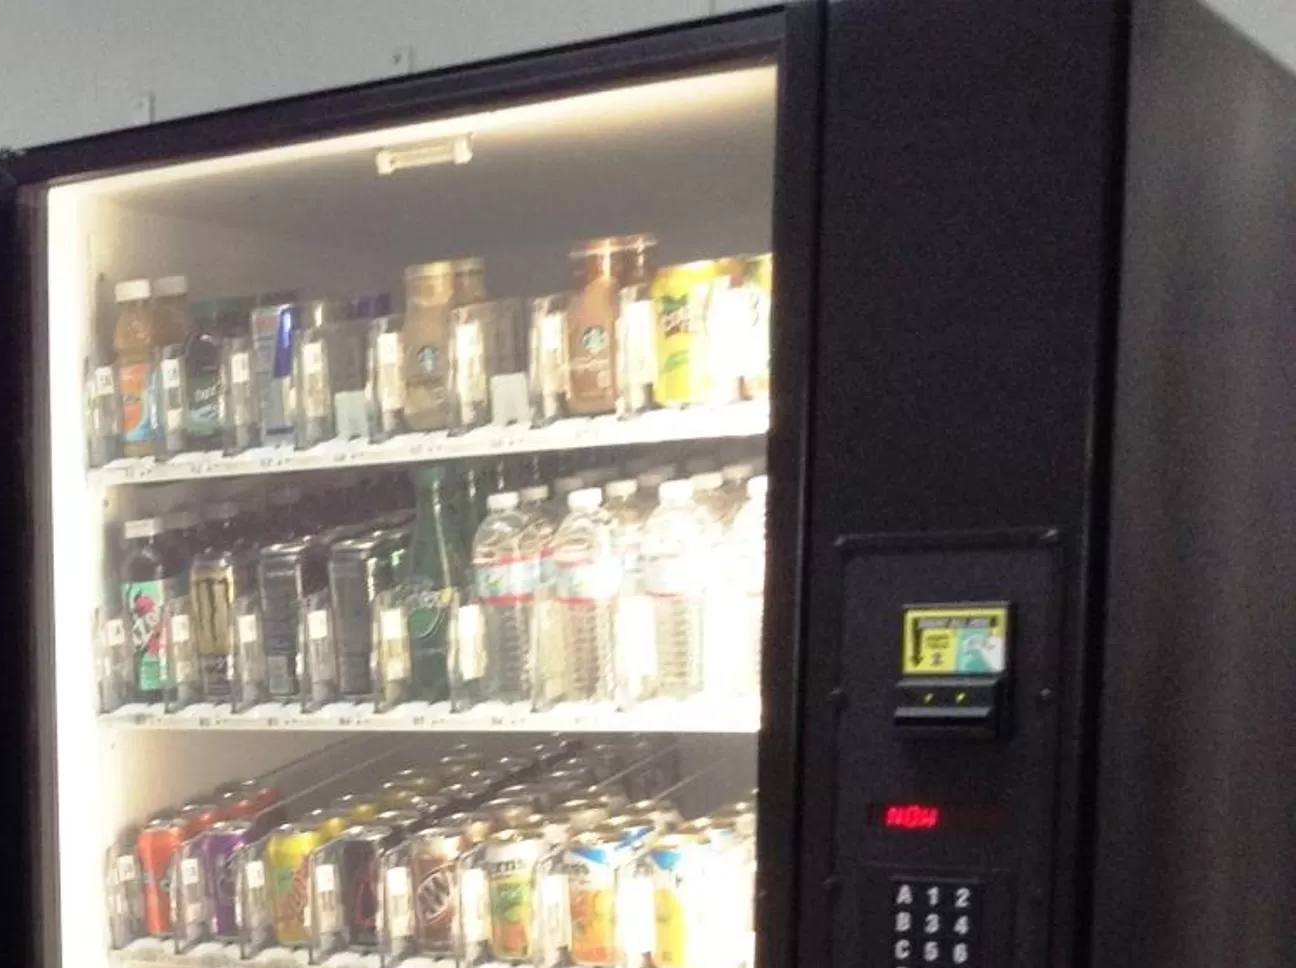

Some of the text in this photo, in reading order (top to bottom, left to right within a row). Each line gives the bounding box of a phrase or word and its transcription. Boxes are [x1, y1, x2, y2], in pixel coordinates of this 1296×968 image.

[897, 885, 970, 907] A 1 2
[896, 912, 969, 935] B 3 4
[895, 940, 910, 959] C
